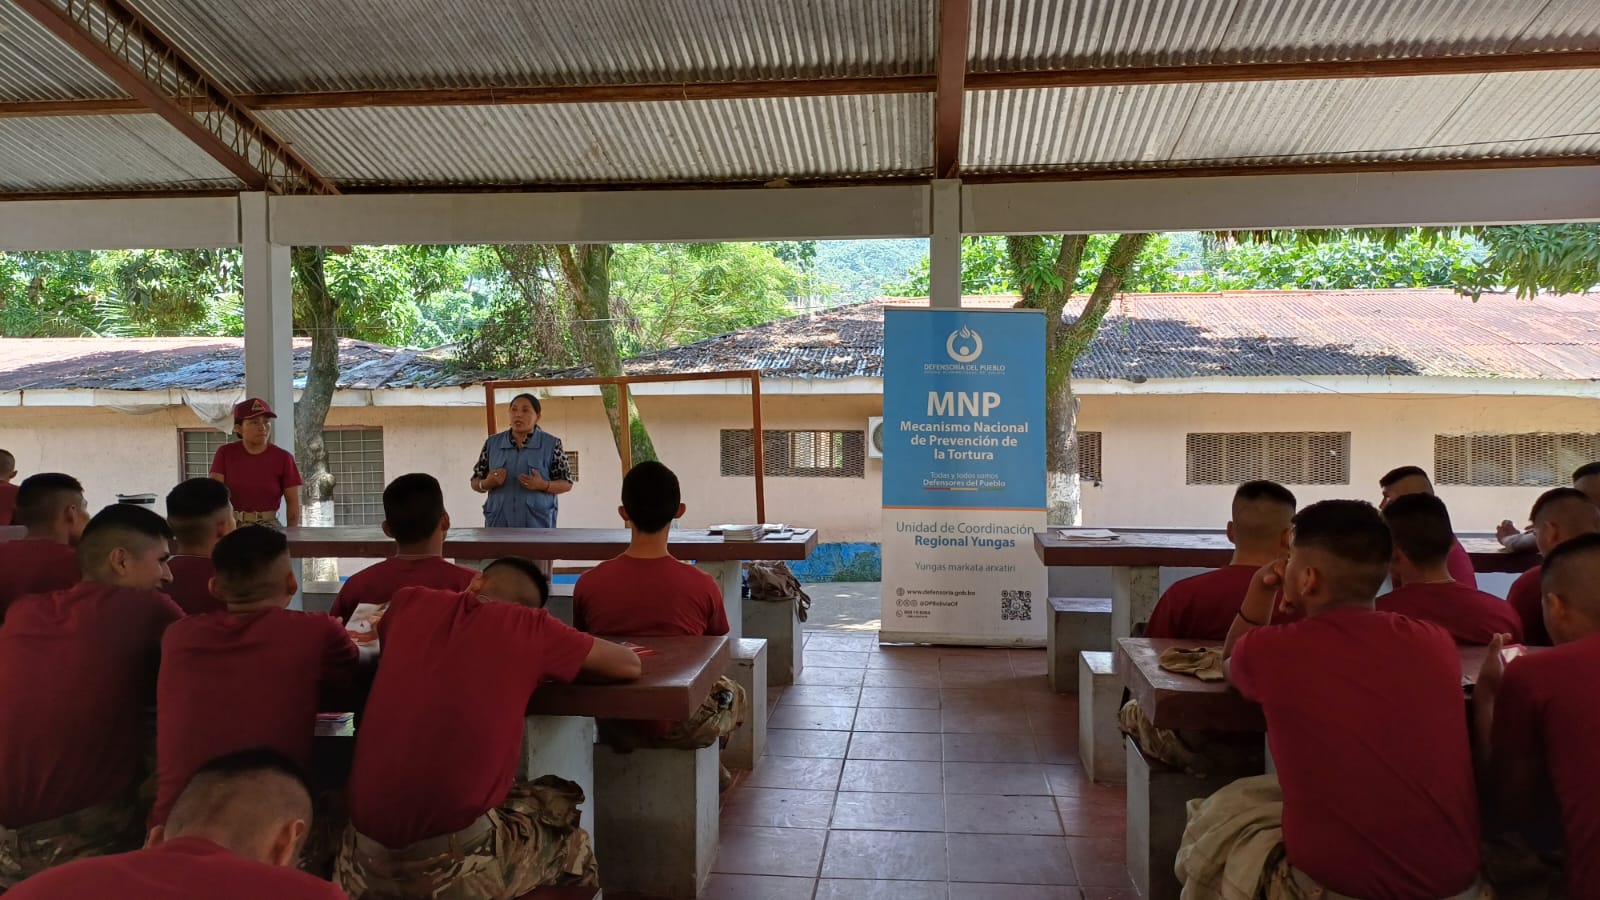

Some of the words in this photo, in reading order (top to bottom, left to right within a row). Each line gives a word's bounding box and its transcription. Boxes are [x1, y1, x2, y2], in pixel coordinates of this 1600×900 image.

[927, 391, 1001, 417] MNP
[900, 421, 971, 432] Mecanismo
[974, 422, 1029, 433] Nacional
[911, 435, 927, 445] de
[930, 435, 999, 447] Prevención
[1002, 436, 1018, 447] de
[934, 449, 945, 460] la
[947, 449, 994, 460] Tortura
[931, 471, 950, 479] Todas
[923, 479, 965, 487] Defensores
[966, 479, 978, 487] del
[896, 521, 937, 533] Unidad
[940, 522, 955, 533] de
[957, 522, 1035, 535] Coordinación
[914, 536, 968, 549] Regional
[971, 537, 1016, 550] Yungas
[914, 561, 946, 573] Yungas
[948, 562, 983, 572] markata
[985, 562, 1016, 573] arxatiri
